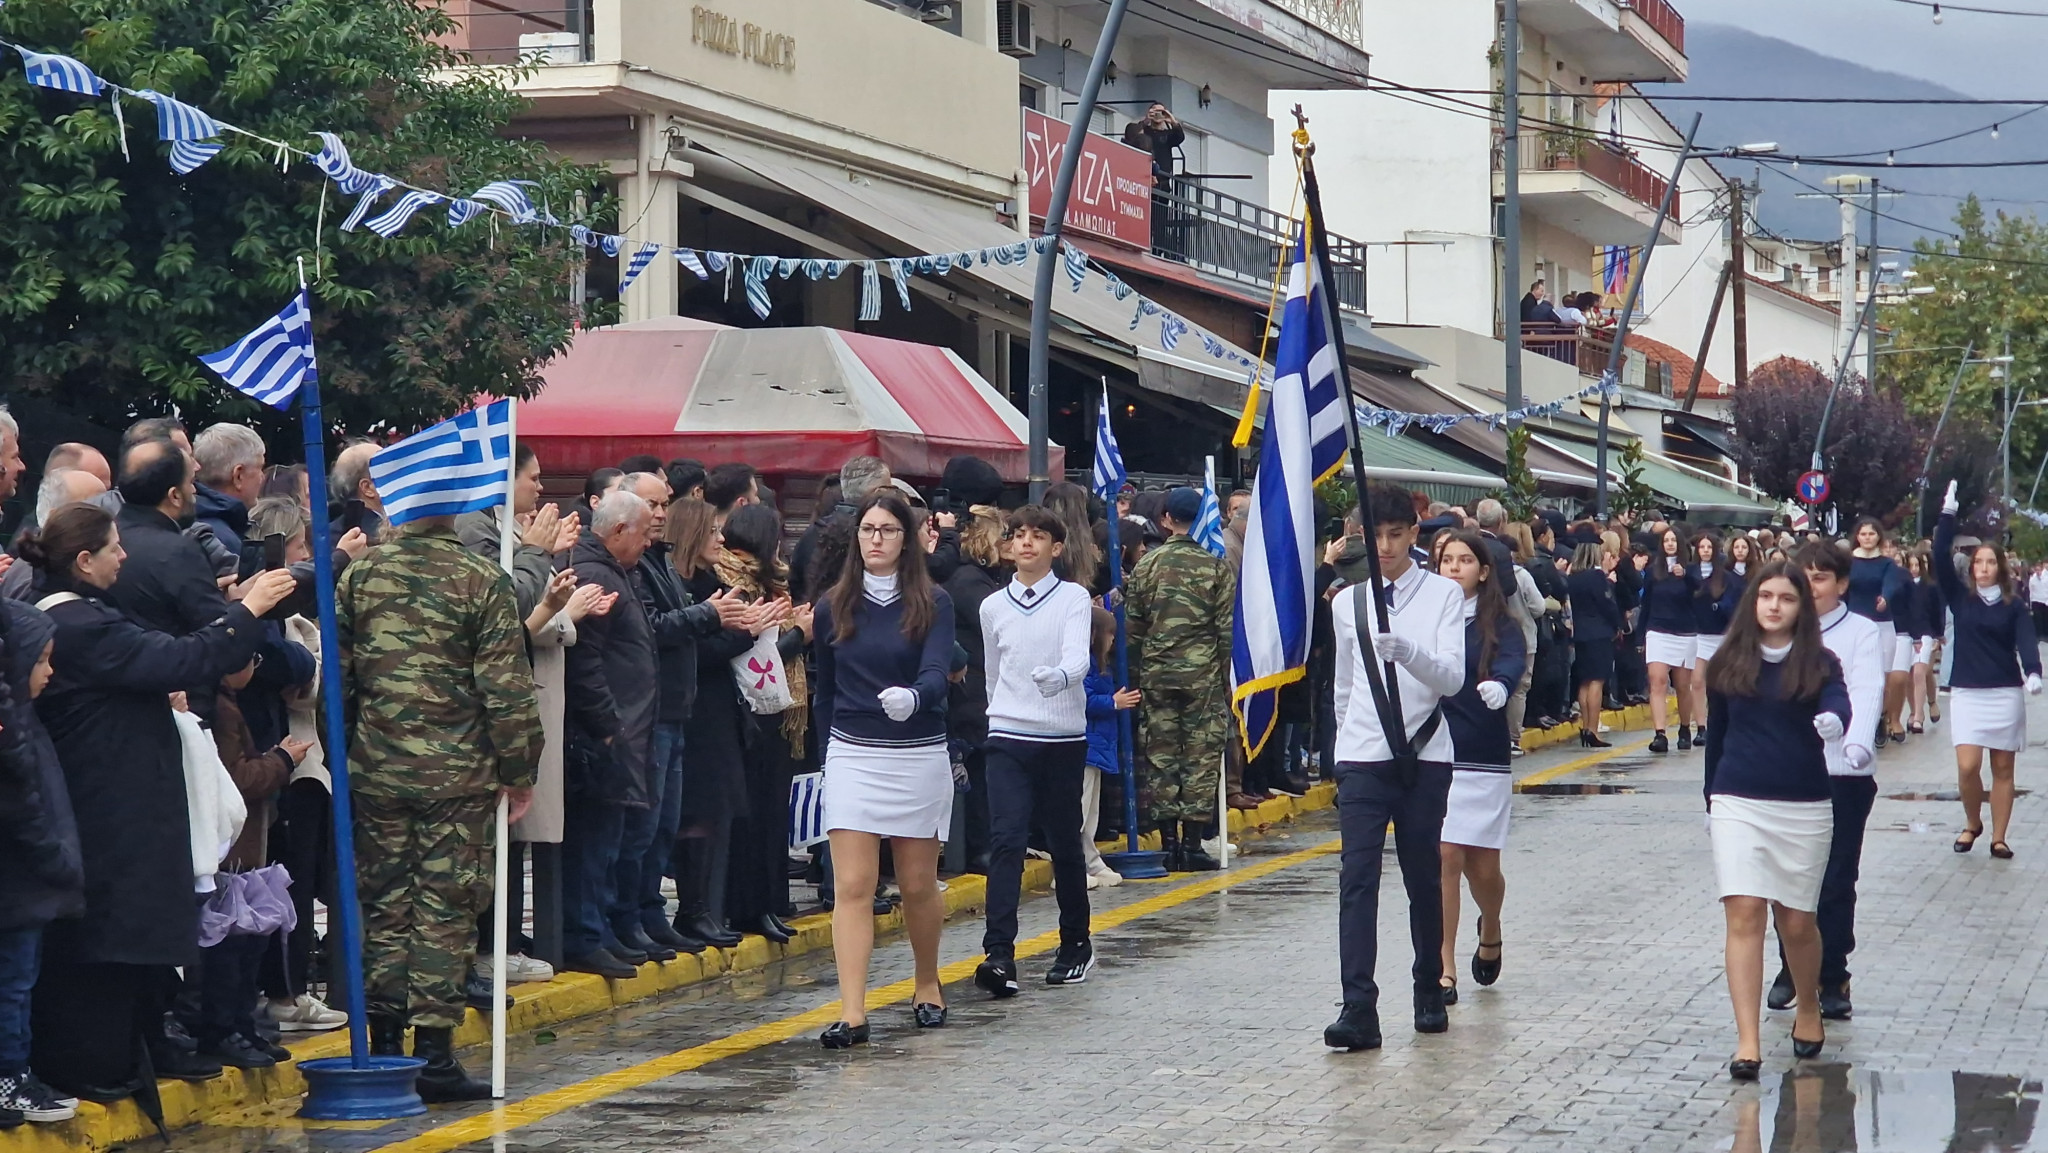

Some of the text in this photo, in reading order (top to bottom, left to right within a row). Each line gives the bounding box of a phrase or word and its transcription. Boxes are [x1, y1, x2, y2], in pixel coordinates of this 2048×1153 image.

[692, 5, 795, 71] PIZZA PLACE
[1027, 119, 1115, 211] ΣΥΙΖΑ
[1074, 210, 1116, 236] ΑΛΜΩΠΙΑΣ
[1120, 201, 1144, 220] ΣΥΜΜΑΧΙΑ
